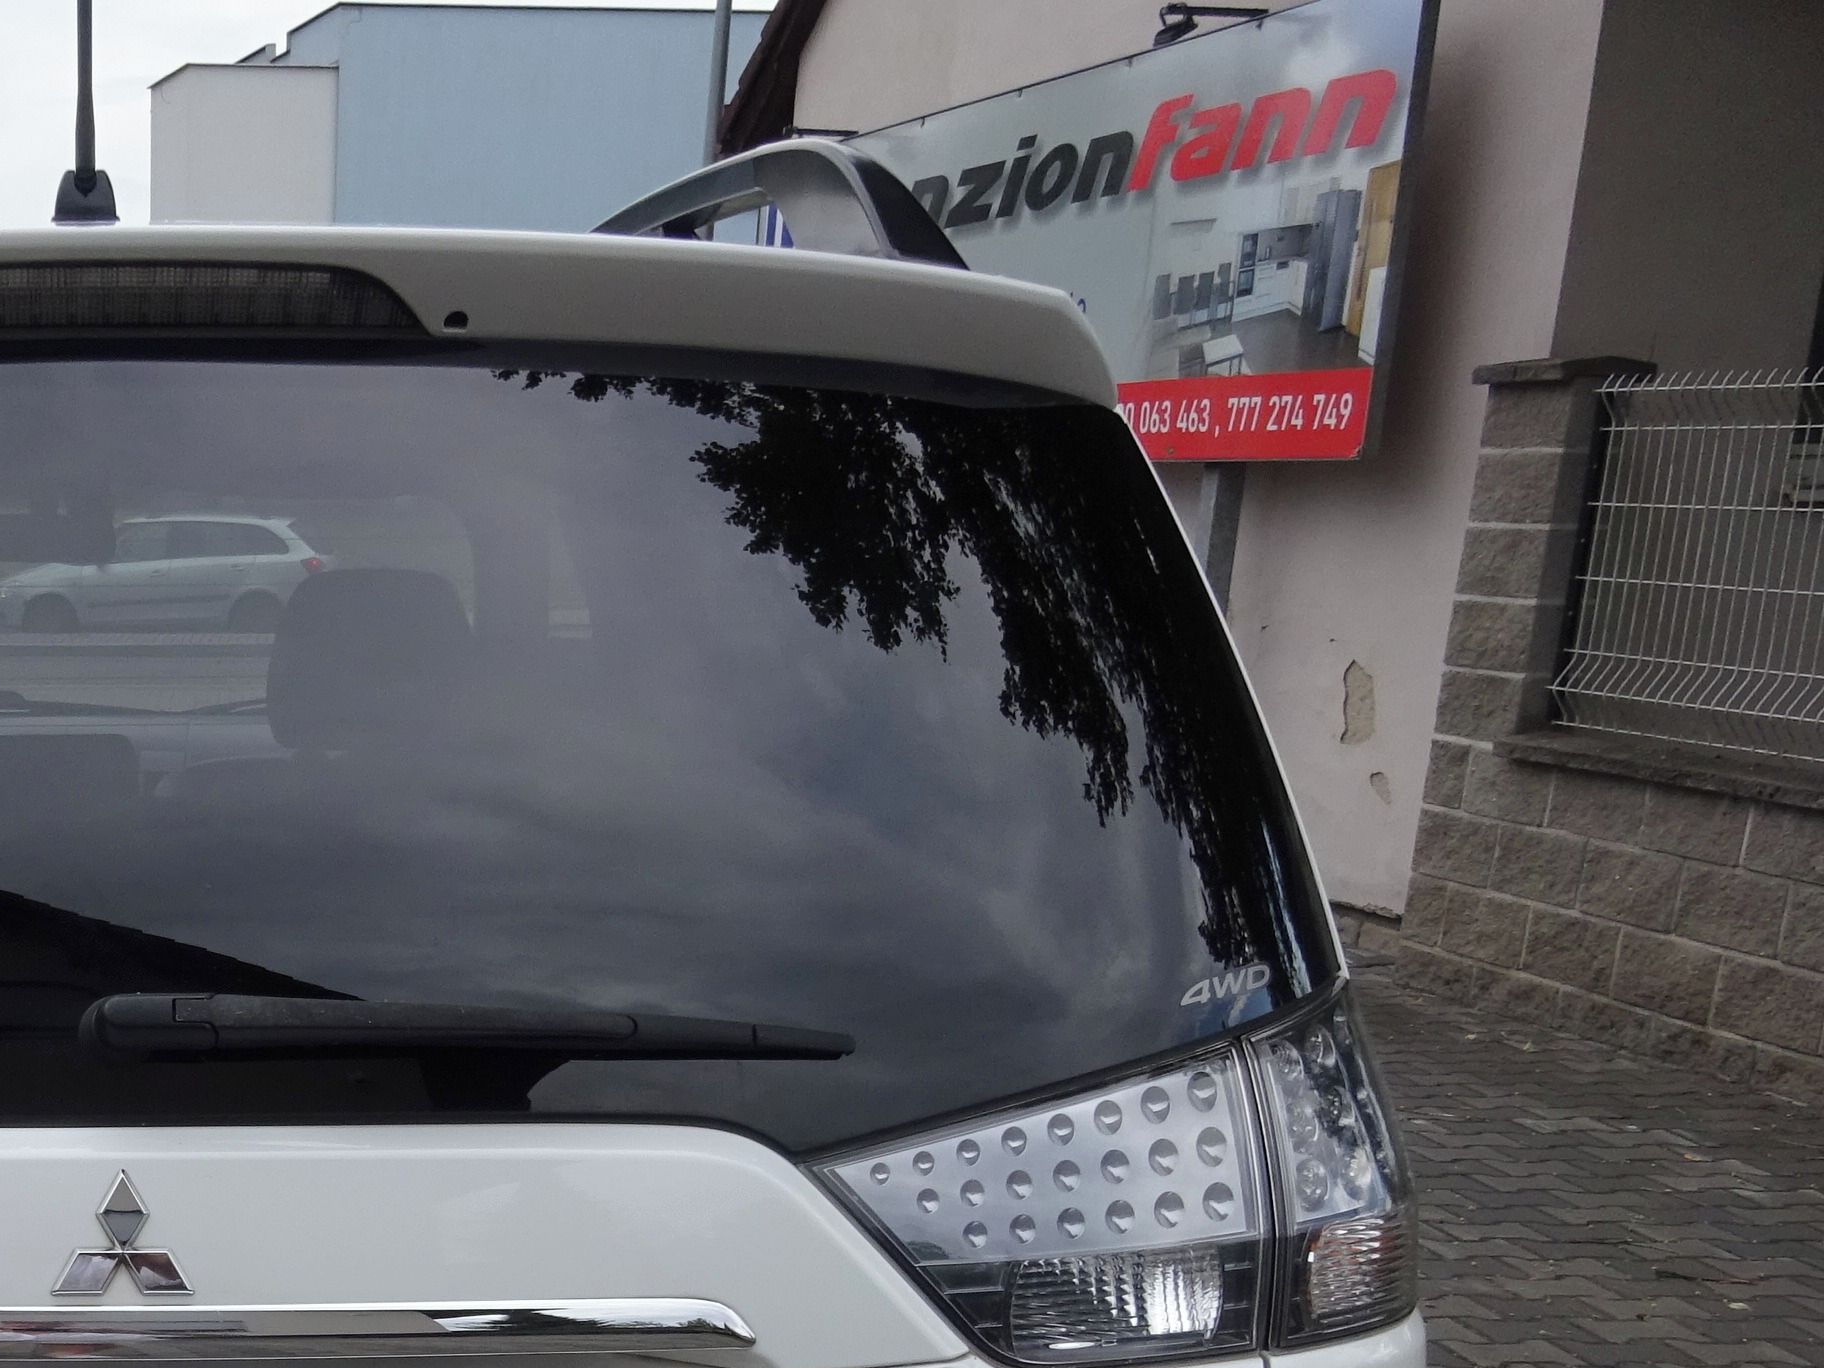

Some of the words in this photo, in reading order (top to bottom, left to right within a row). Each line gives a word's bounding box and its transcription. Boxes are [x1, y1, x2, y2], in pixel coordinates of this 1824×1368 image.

[1139, 400, 1171, 434] 063
[1227, 396, 1262, 432] 777
[1266, 395, 1304, 431] 274
[1312, 392, 1353, 430] 749
[1180, 964, 1270, 1006] 4WD
